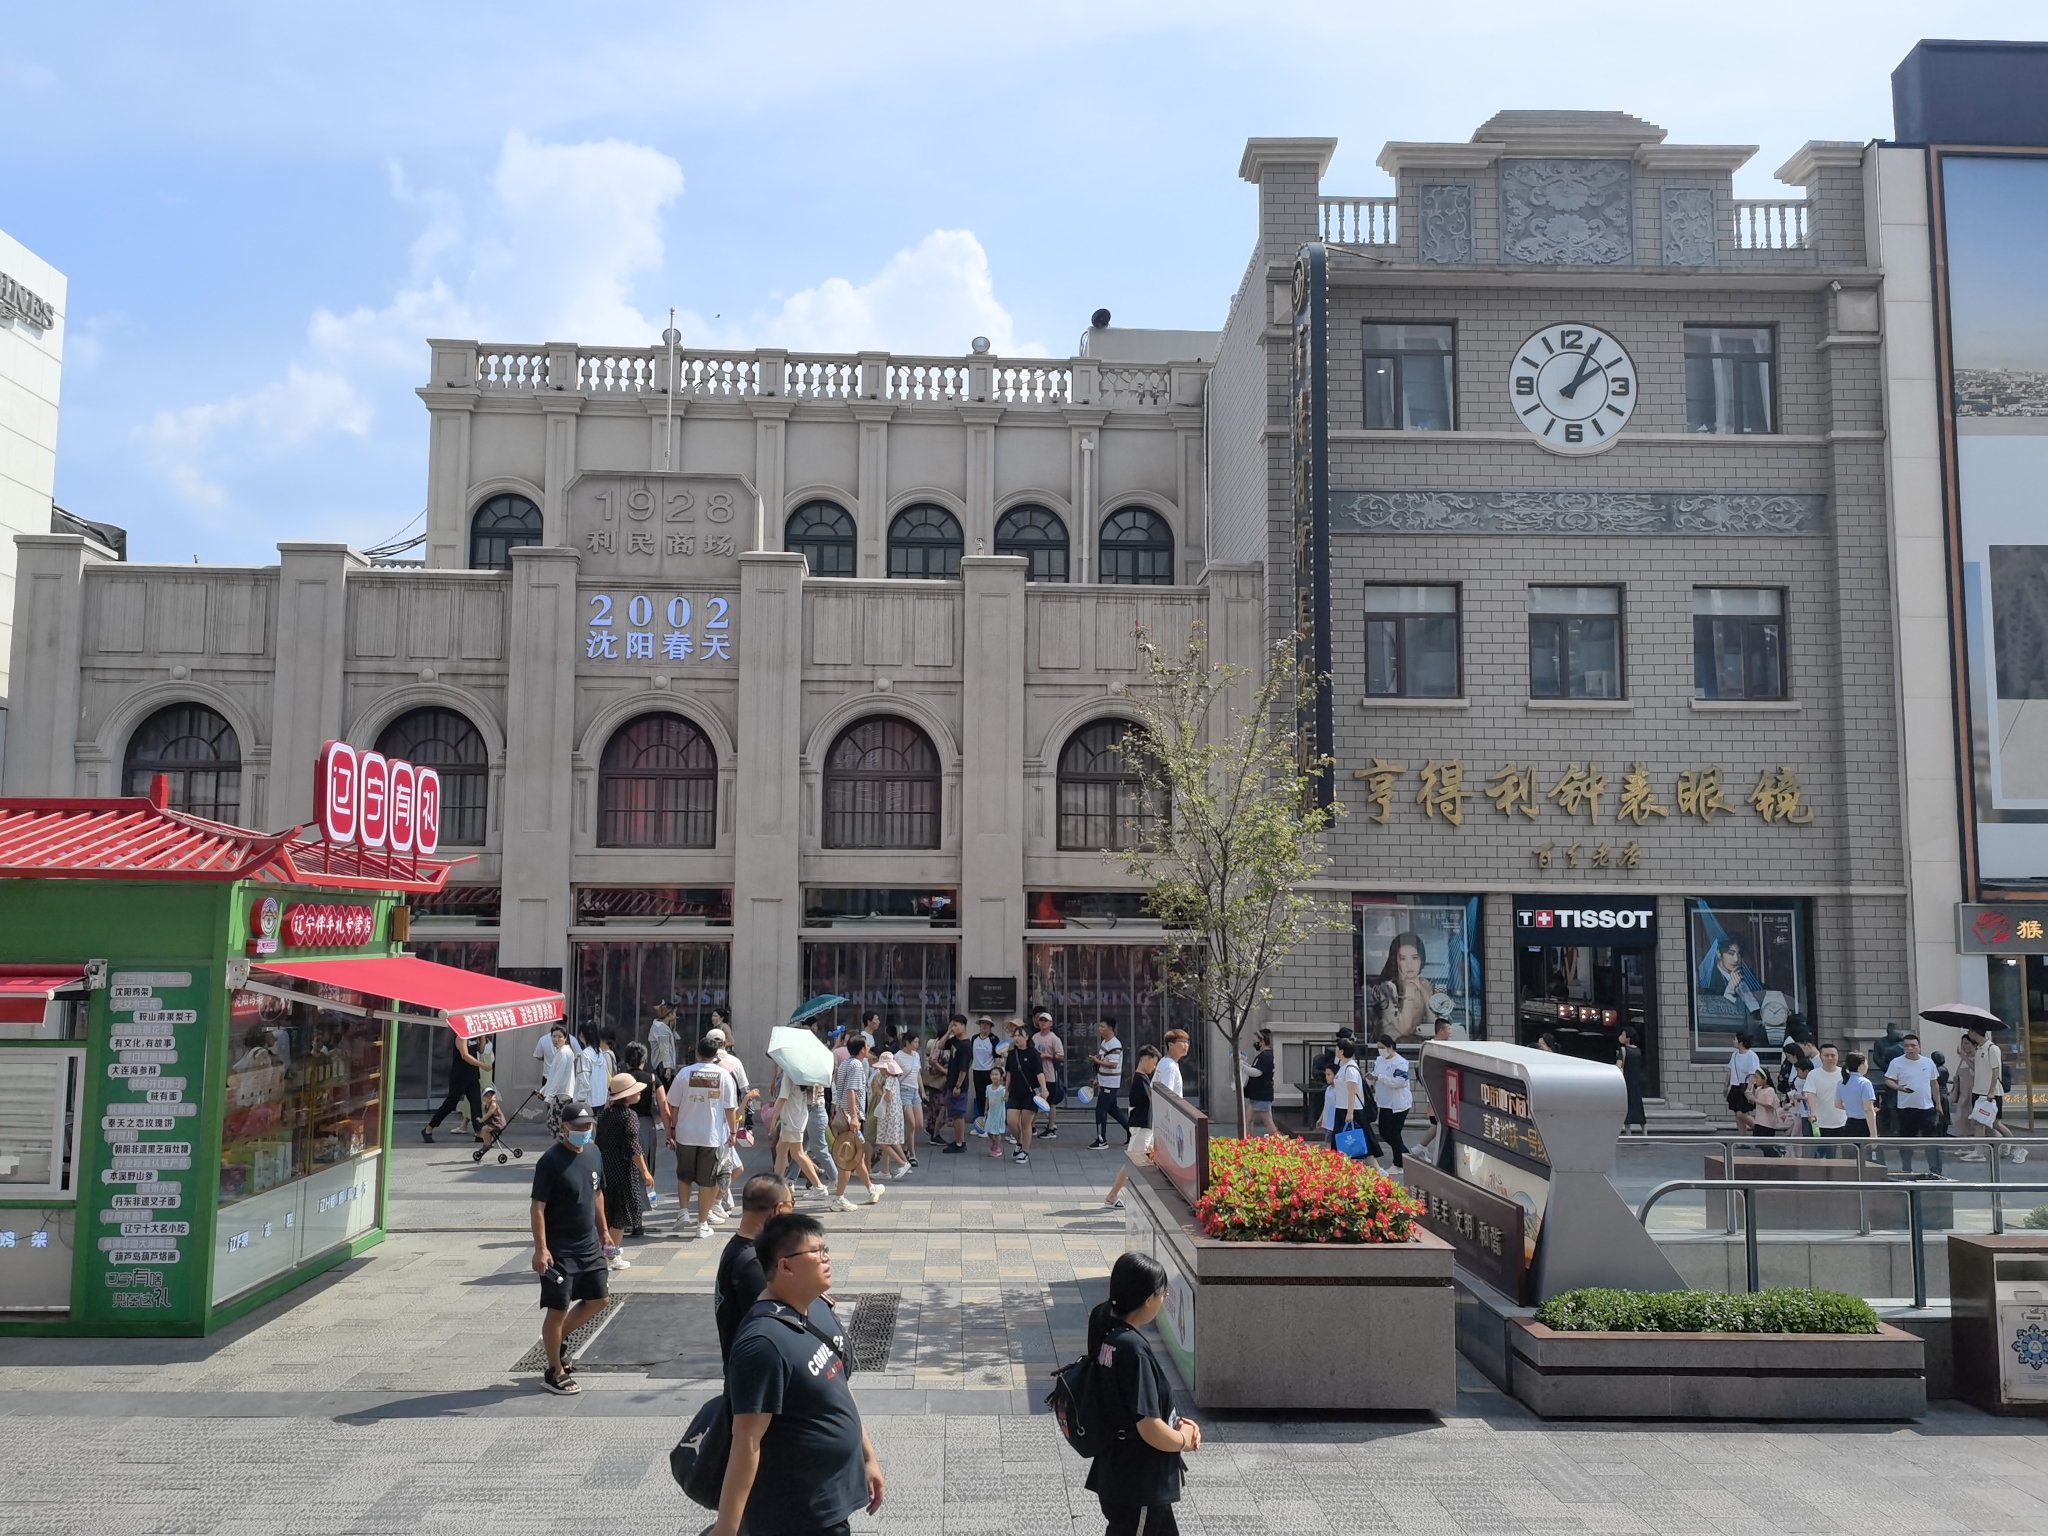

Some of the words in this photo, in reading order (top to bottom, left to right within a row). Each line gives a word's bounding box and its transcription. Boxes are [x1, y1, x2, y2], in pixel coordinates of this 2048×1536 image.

[0, 271, 54, 331] INES
[1560, 329, 1583, 350] 12
[1515, 376, 1534, 396] 9
[1610, 376, 1630, 396] 3
[1564, 423, 1583, 442] 6
[594, 488, 735, 524] 1928
[587, 529, 736, 557] 利民商场
[588, 594, 730, 630] 2002
[586, 630, 731, 661] 沈阳春天
[332, 766, 436, 832] 辽宁有礼
[1354, 758, 1815, 826] 亨得利钟表眼镜
[293, 913, 372, 936] 辽宁伴手礼专营店
[1554, 909, 1653, 929] TISSOT
[2016, 920, 2044, 940] 猴
[115, 988, 150, 997] 沈阳鸡架
[139, 1012, 193, 1021] 鞍山南果梨干
[464, 1008, 518, 1035] 把辽宁美好味道
[111, 1066, 158, 1075] 大连海参酥
[150, 1091, 178, 1101] 贼有面
[1481, 1083, 1532, 1119] 中街地下商
[108, 1119, 173, 1128] 奉天之恋玫瑰饼
[110, 1171, 154, 1181] 本溪野山参
[115, 1196, 177, 1206] 丹东非遗叉子面
[124, 1223, 187, 1234] 辽宁十大名小吃
[1431, 1196, 1450, 1226] 民主
[1454, 1208, 1474, 1240] 文明
[1479, 1220, 1503, 1257] 和谐
[115, 1251, 177, 1261] 葫芦岛葫芦烙画
